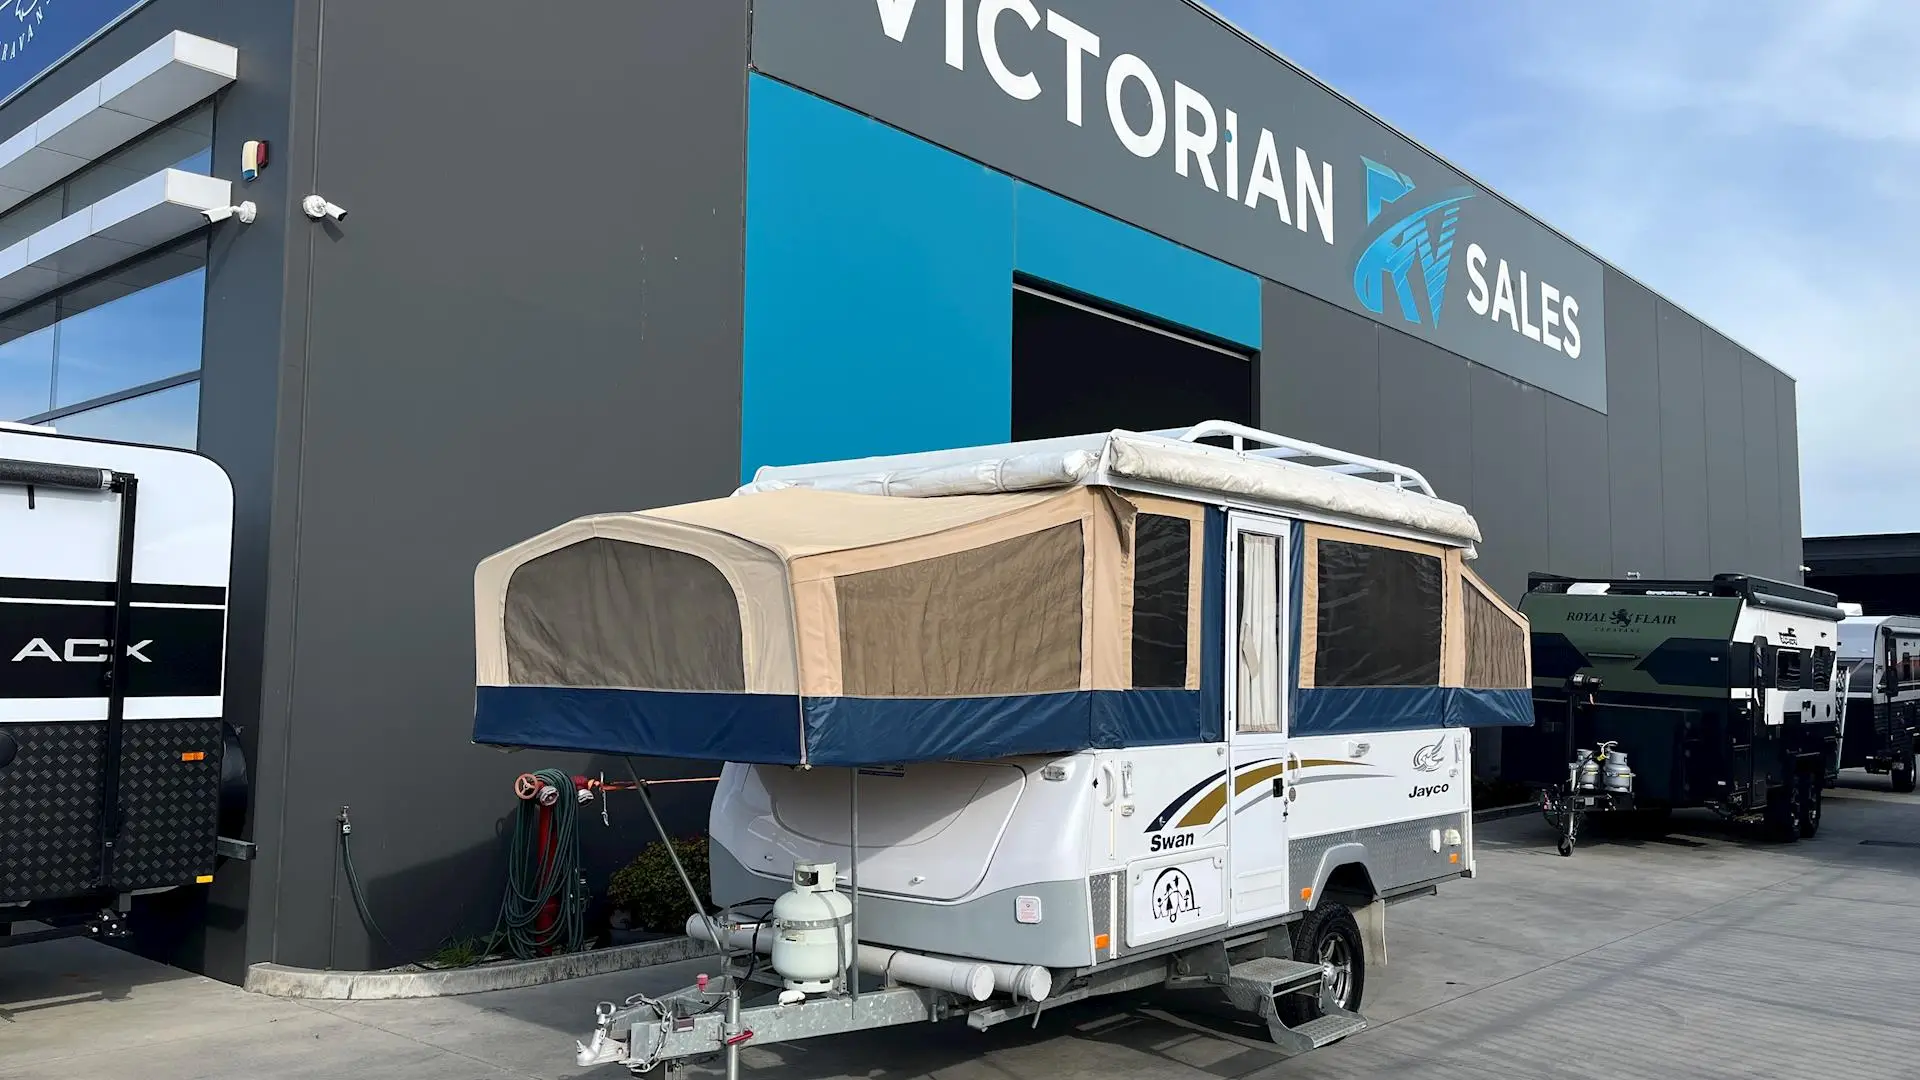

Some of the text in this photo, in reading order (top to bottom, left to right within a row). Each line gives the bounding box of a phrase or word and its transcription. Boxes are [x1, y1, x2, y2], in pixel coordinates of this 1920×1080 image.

[0, 0, 50, 61] RAVAN
[1466, 243, 1582, 359] SALES
[1566, 611, 1677, 625] ROYAL FLAIR
[1408, 783, 1450, 798] Jayco
[1150, 832, 1195, 852] Swan
